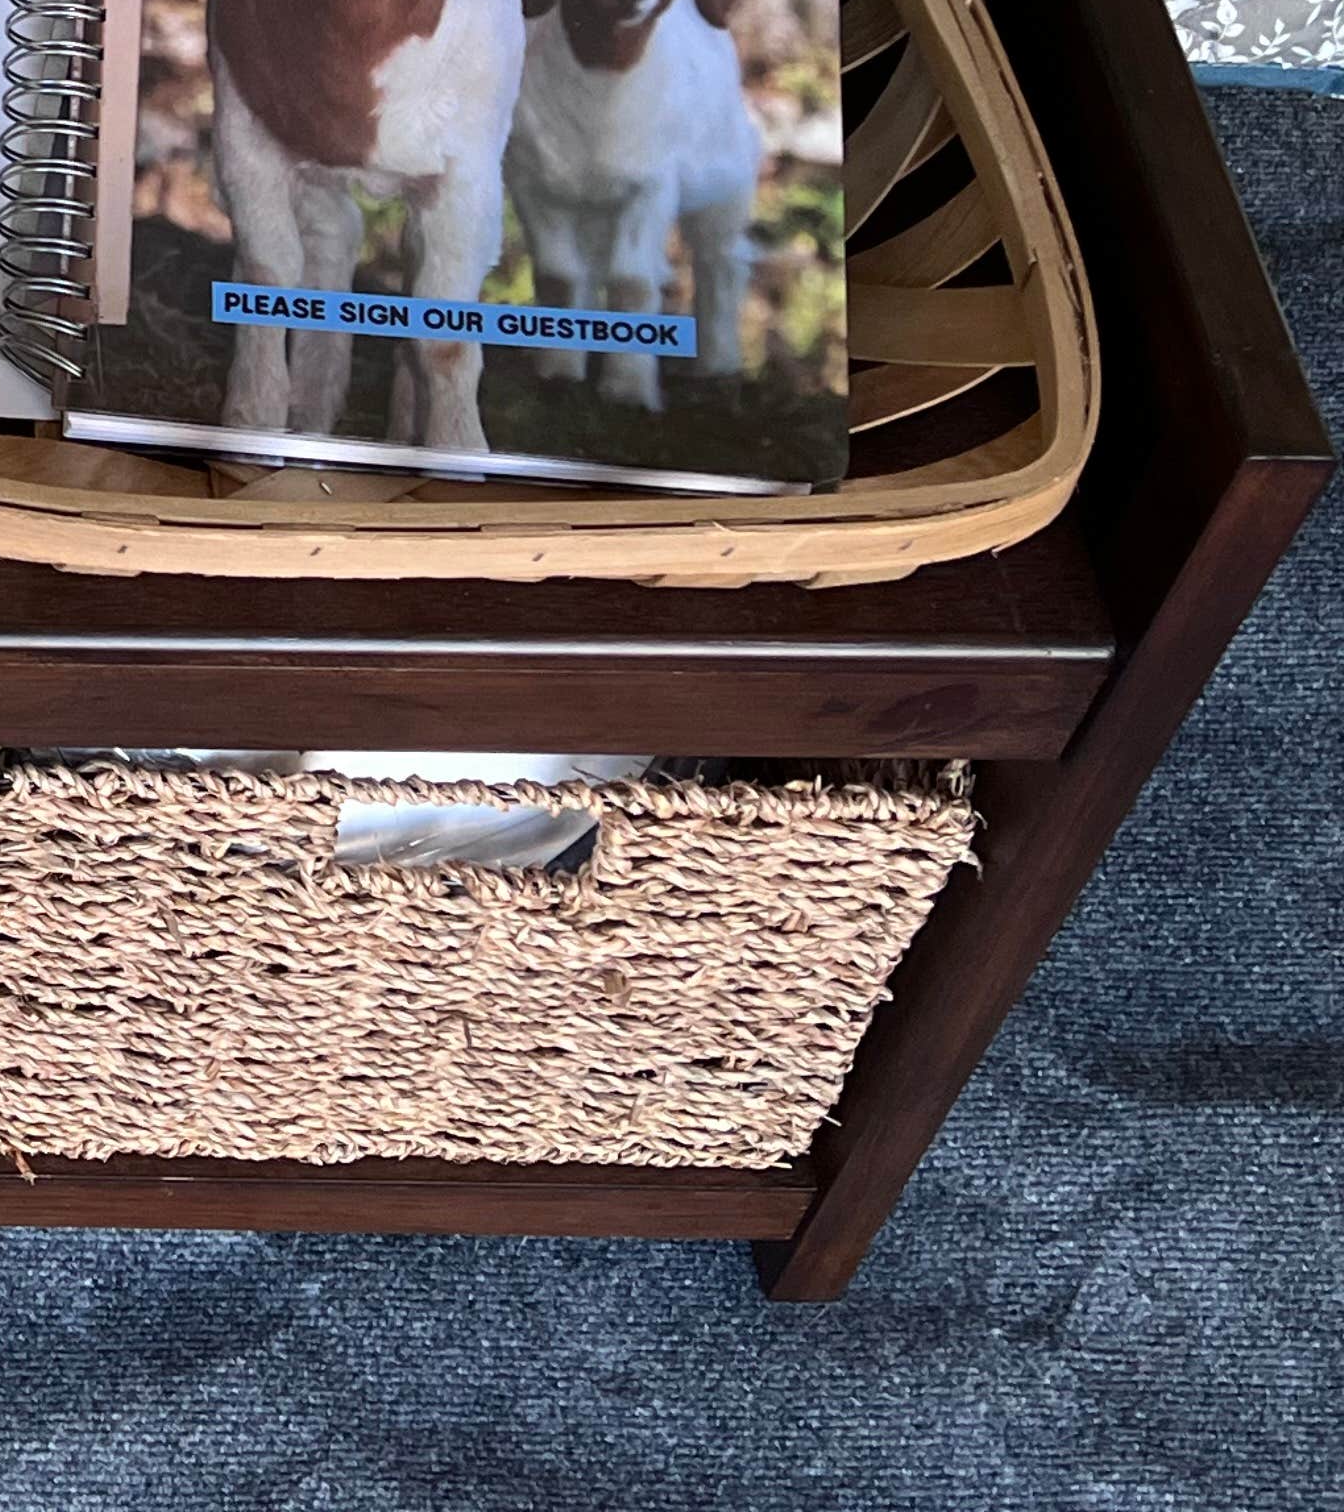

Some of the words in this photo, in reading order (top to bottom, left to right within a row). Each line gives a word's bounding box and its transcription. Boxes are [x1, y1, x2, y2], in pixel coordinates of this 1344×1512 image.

[223, 291, 327, 322] PLEASE
[338, 300, 410, 328] SIGN
[423, 307, 484, 334] OUR
[497, 313, 679, 347] GUESTBOOK
